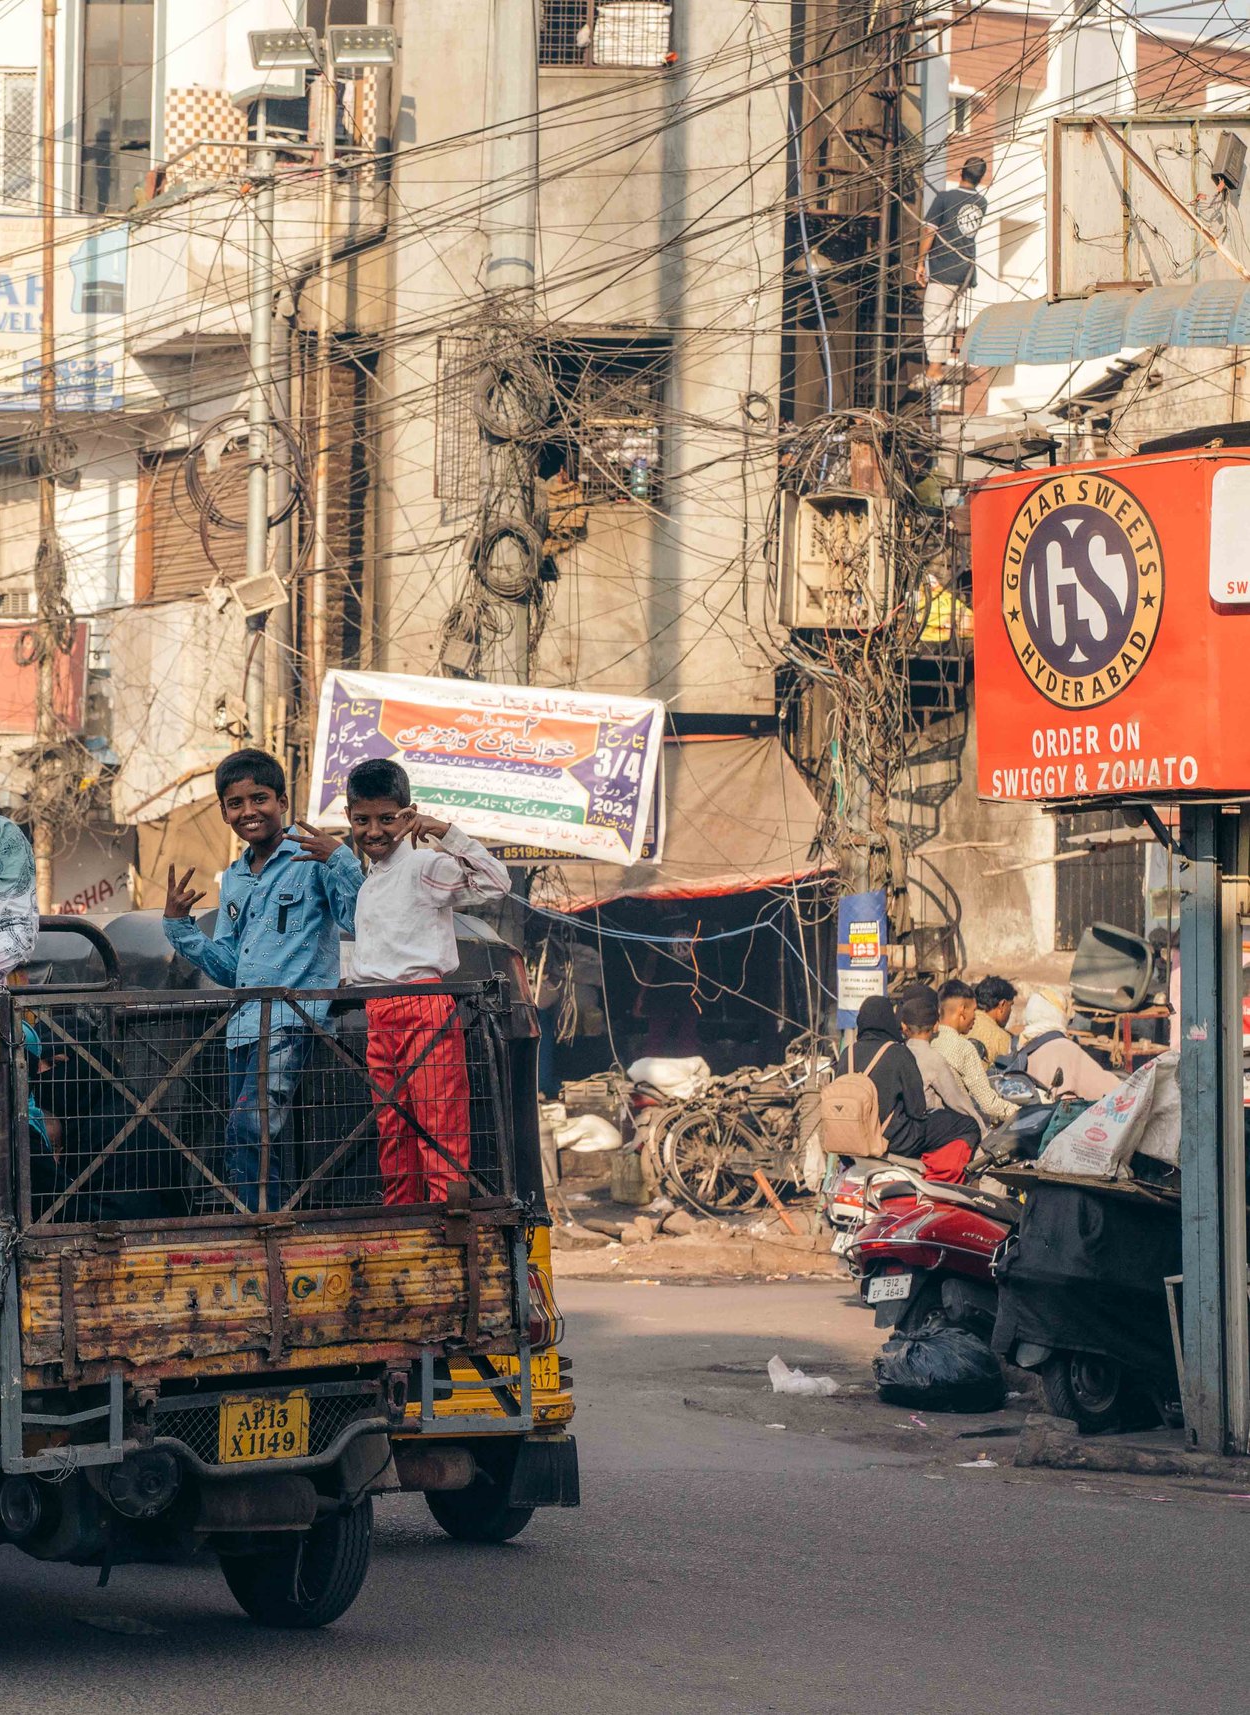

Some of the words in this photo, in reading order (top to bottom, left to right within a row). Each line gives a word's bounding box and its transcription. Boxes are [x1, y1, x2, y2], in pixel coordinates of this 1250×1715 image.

[1006, 483, 1066, 590] GULZAR
[1076, 479, 1158, 577] SWEETS
[1020, 633, 1147, 706] HYDERABAD
[1032, 726, 1101, 760] ORDER
[1110, 722, 1141, 752] ON
[593, 748, 641, 784] 3/4
[992, 764, 1068, 799] SWIGGY
[1075, 764, 1088, 796] &
[1097, 755, 1199, 792] ZOMATO
[592, 799, 634, 819] 2024
[59, 878, 114, 915] ASHA
[872, 1289, 882, 1299] EF
[885, 1287, 905, 1298] 4645
[882, 1278, 900, 1288] TS12
[238, 1408, 289, 1431] AP.13
